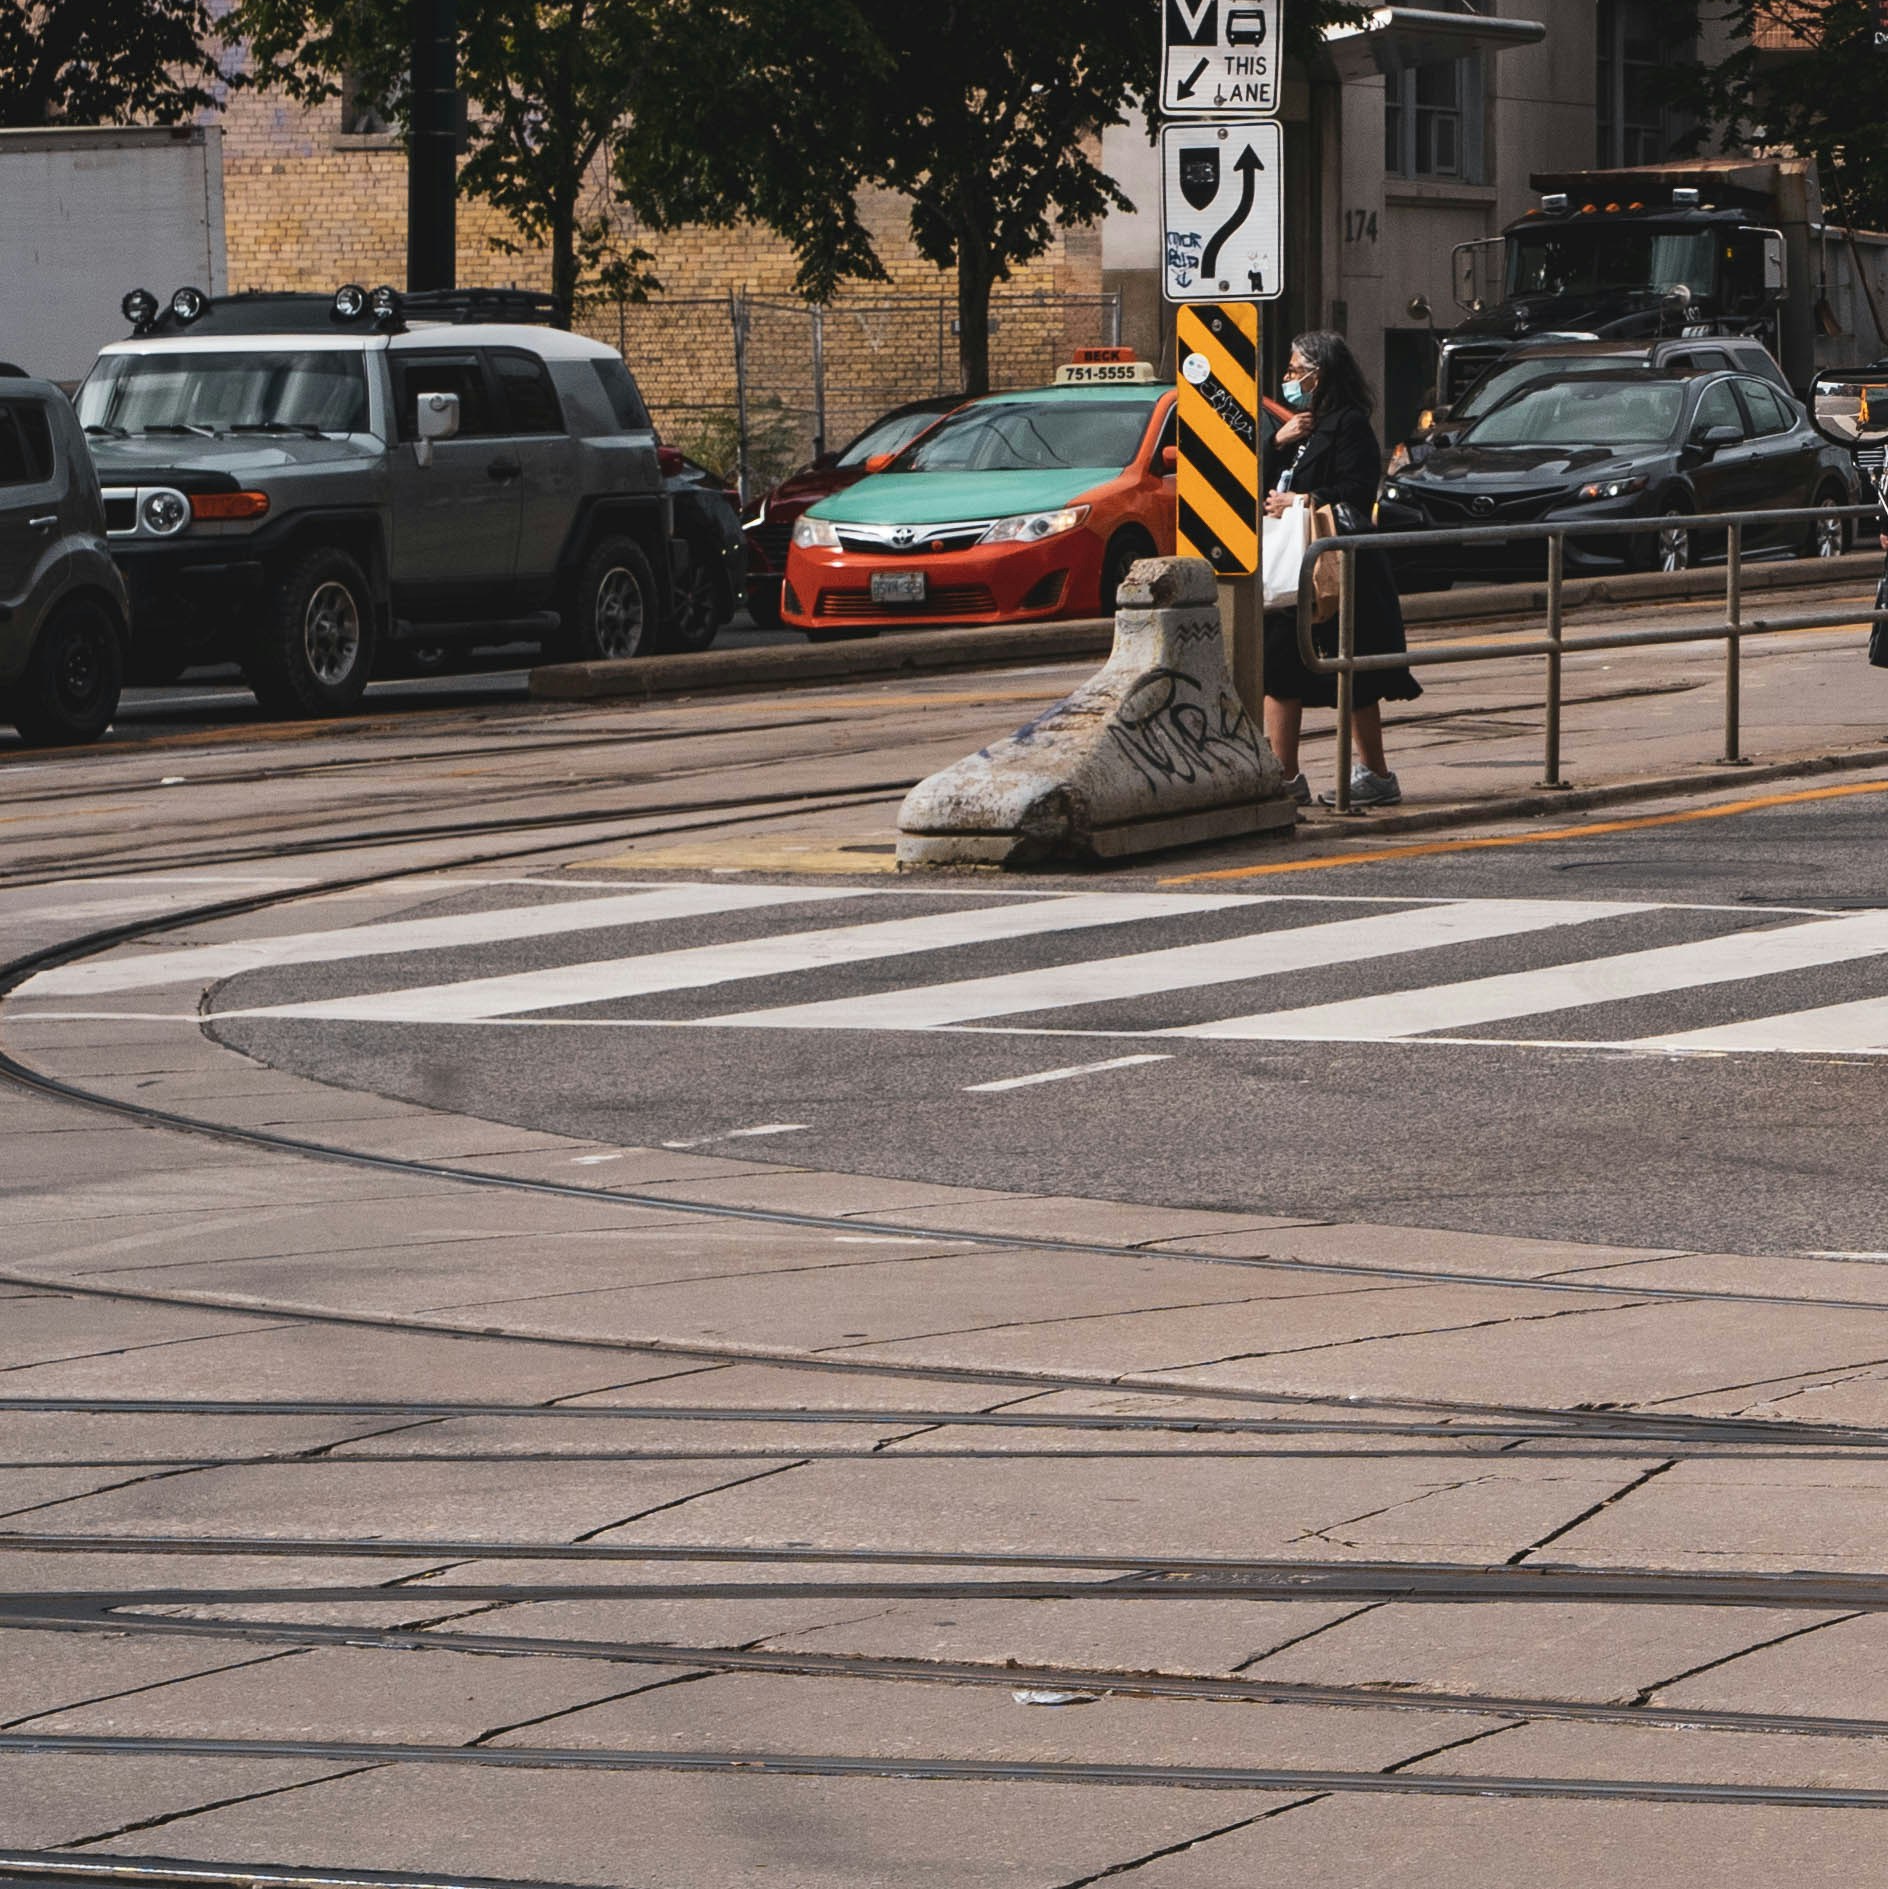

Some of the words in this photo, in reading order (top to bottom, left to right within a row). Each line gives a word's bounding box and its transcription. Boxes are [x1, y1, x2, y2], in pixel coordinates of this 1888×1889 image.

[1223, 56, 1267, 76] THIS
[1217, 83, 1271, 103] LANE
[1345, 210, 1379, 243] 174
[1084, 350, 1120, 361] BECK
[1066, 366, 1135, 381] 751-5555
